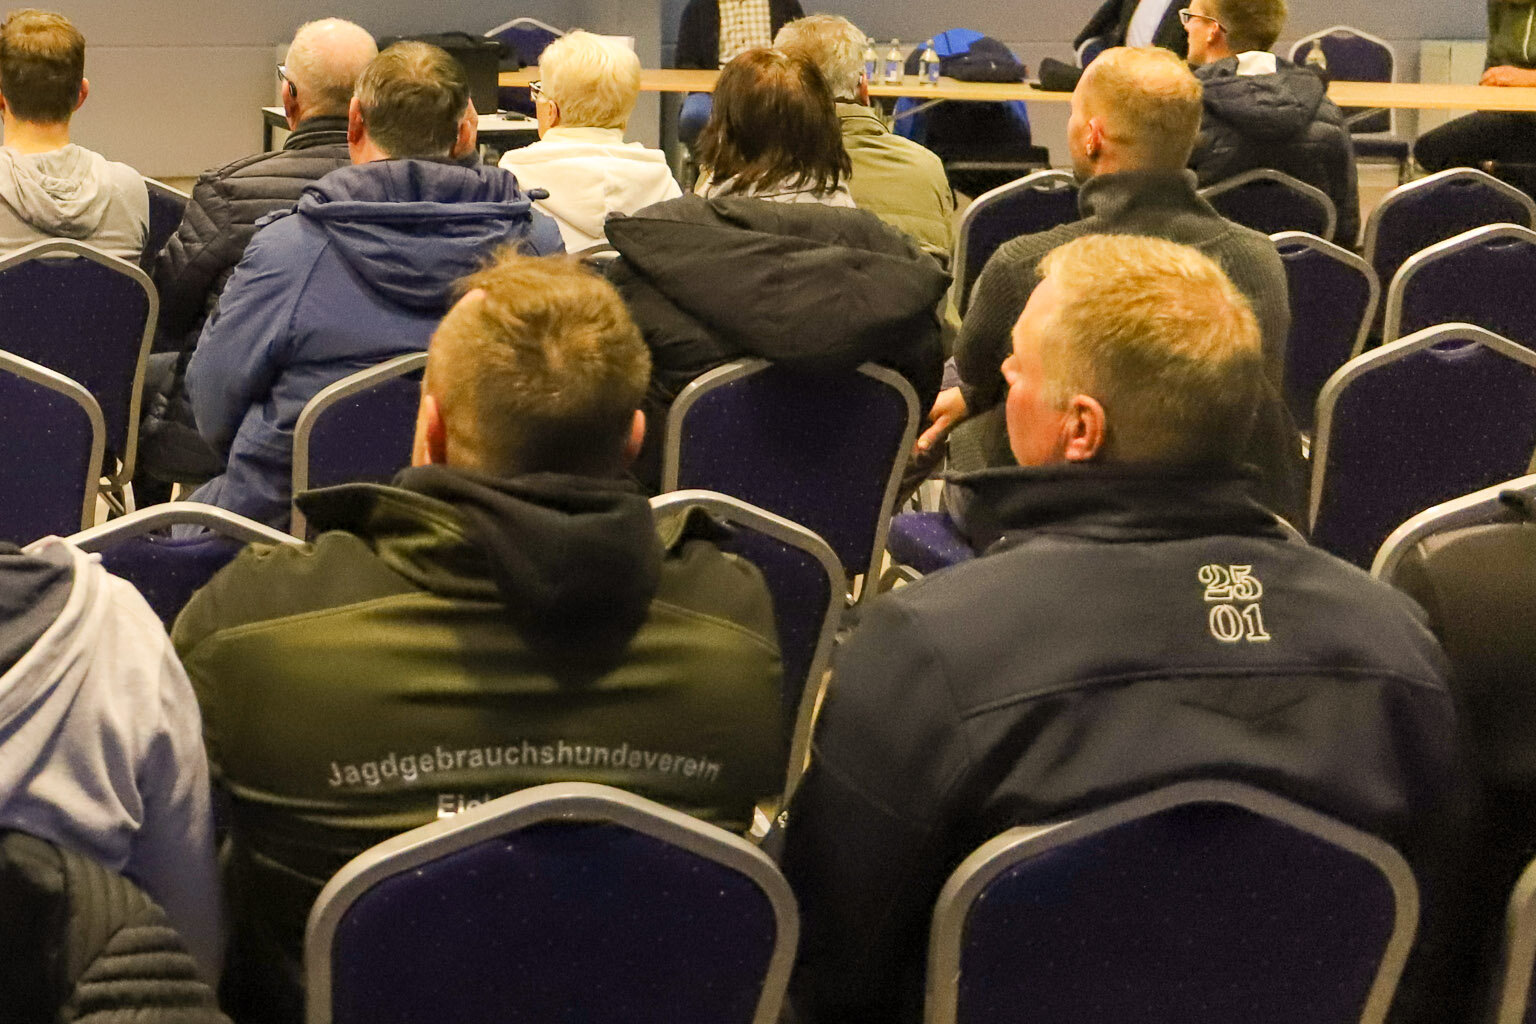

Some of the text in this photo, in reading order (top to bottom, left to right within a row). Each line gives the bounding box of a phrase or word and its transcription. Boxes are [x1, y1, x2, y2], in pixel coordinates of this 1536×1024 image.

[1198, 564, 1263, 601] 25
[1209, 603, 1271, 642] 01
[328, 740, 723, 787] Jagdgebrauchshundeverein
